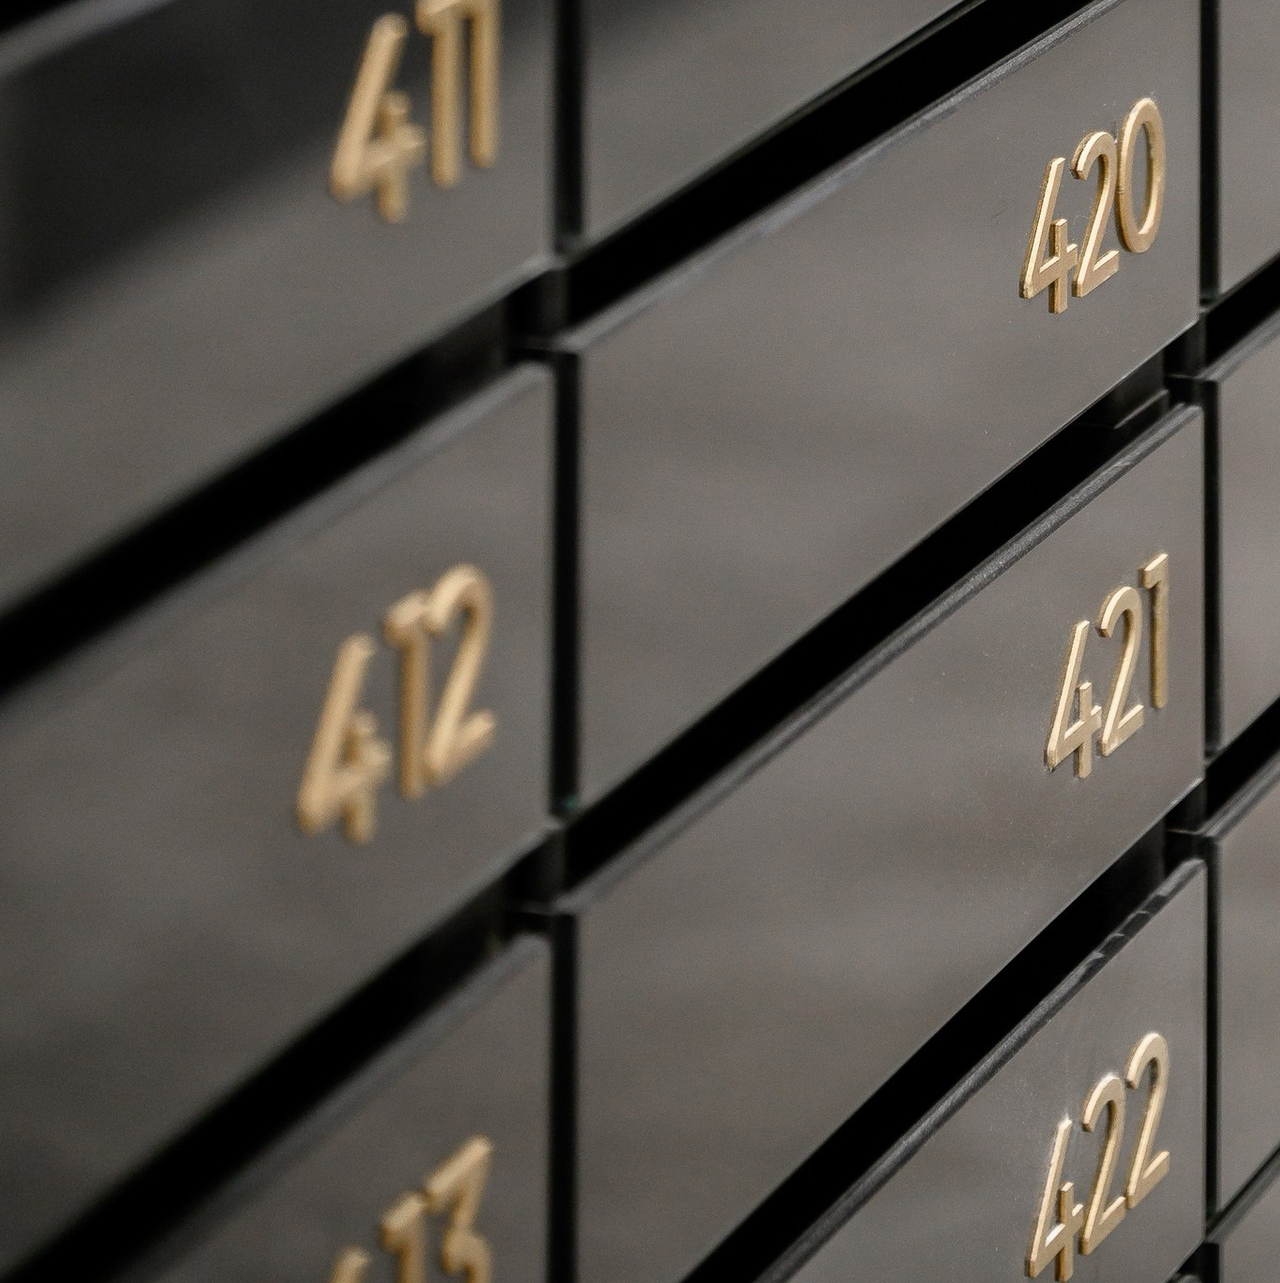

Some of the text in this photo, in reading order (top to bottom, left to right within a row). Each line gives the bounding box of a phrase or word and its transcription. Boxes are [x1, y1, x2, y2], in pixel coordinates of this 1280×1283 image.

[1021, 98, 1164, 313] 420
[298, 565, 494, 841] 412
[1045, 552, 1168, 777] 421
[1026, 1033, 1169, 1282] 422
